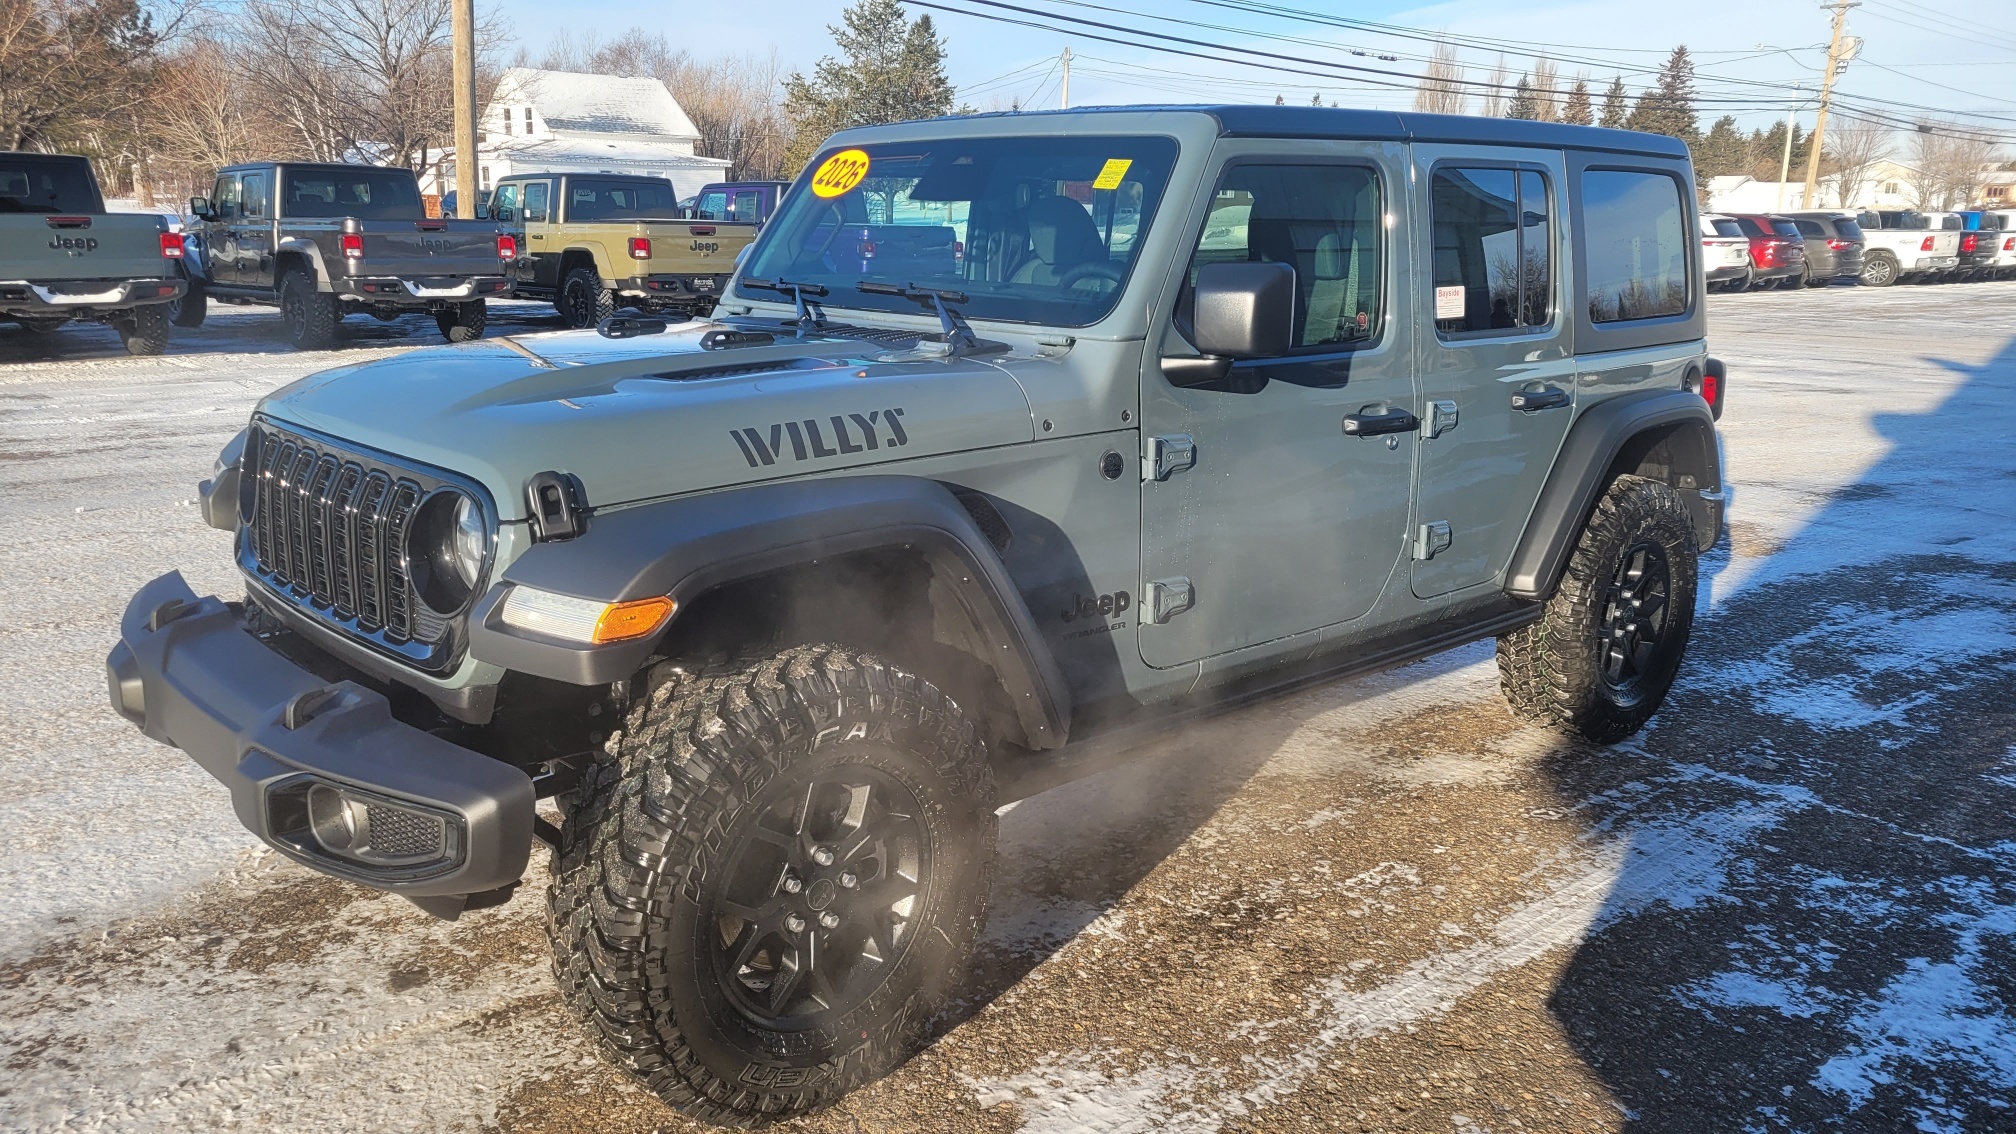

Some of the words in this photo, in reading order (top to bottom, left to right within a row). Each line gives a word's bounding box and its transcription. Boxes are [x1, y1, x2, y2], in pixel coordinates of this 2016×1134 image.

[814, 157, 867, 191] 2026
[47, 234, 98, 252] Jeep
[414, 236, 451, 252] Jeep
[689, 240, 719, 253] Jeep
[1438, 289, 1459, 298] Bayside
[728, 407, 908, 468] WILLYS
[1061, 590, 1131, 622] Jeep
[1062, 621, 1126, 641] WRANGLER
